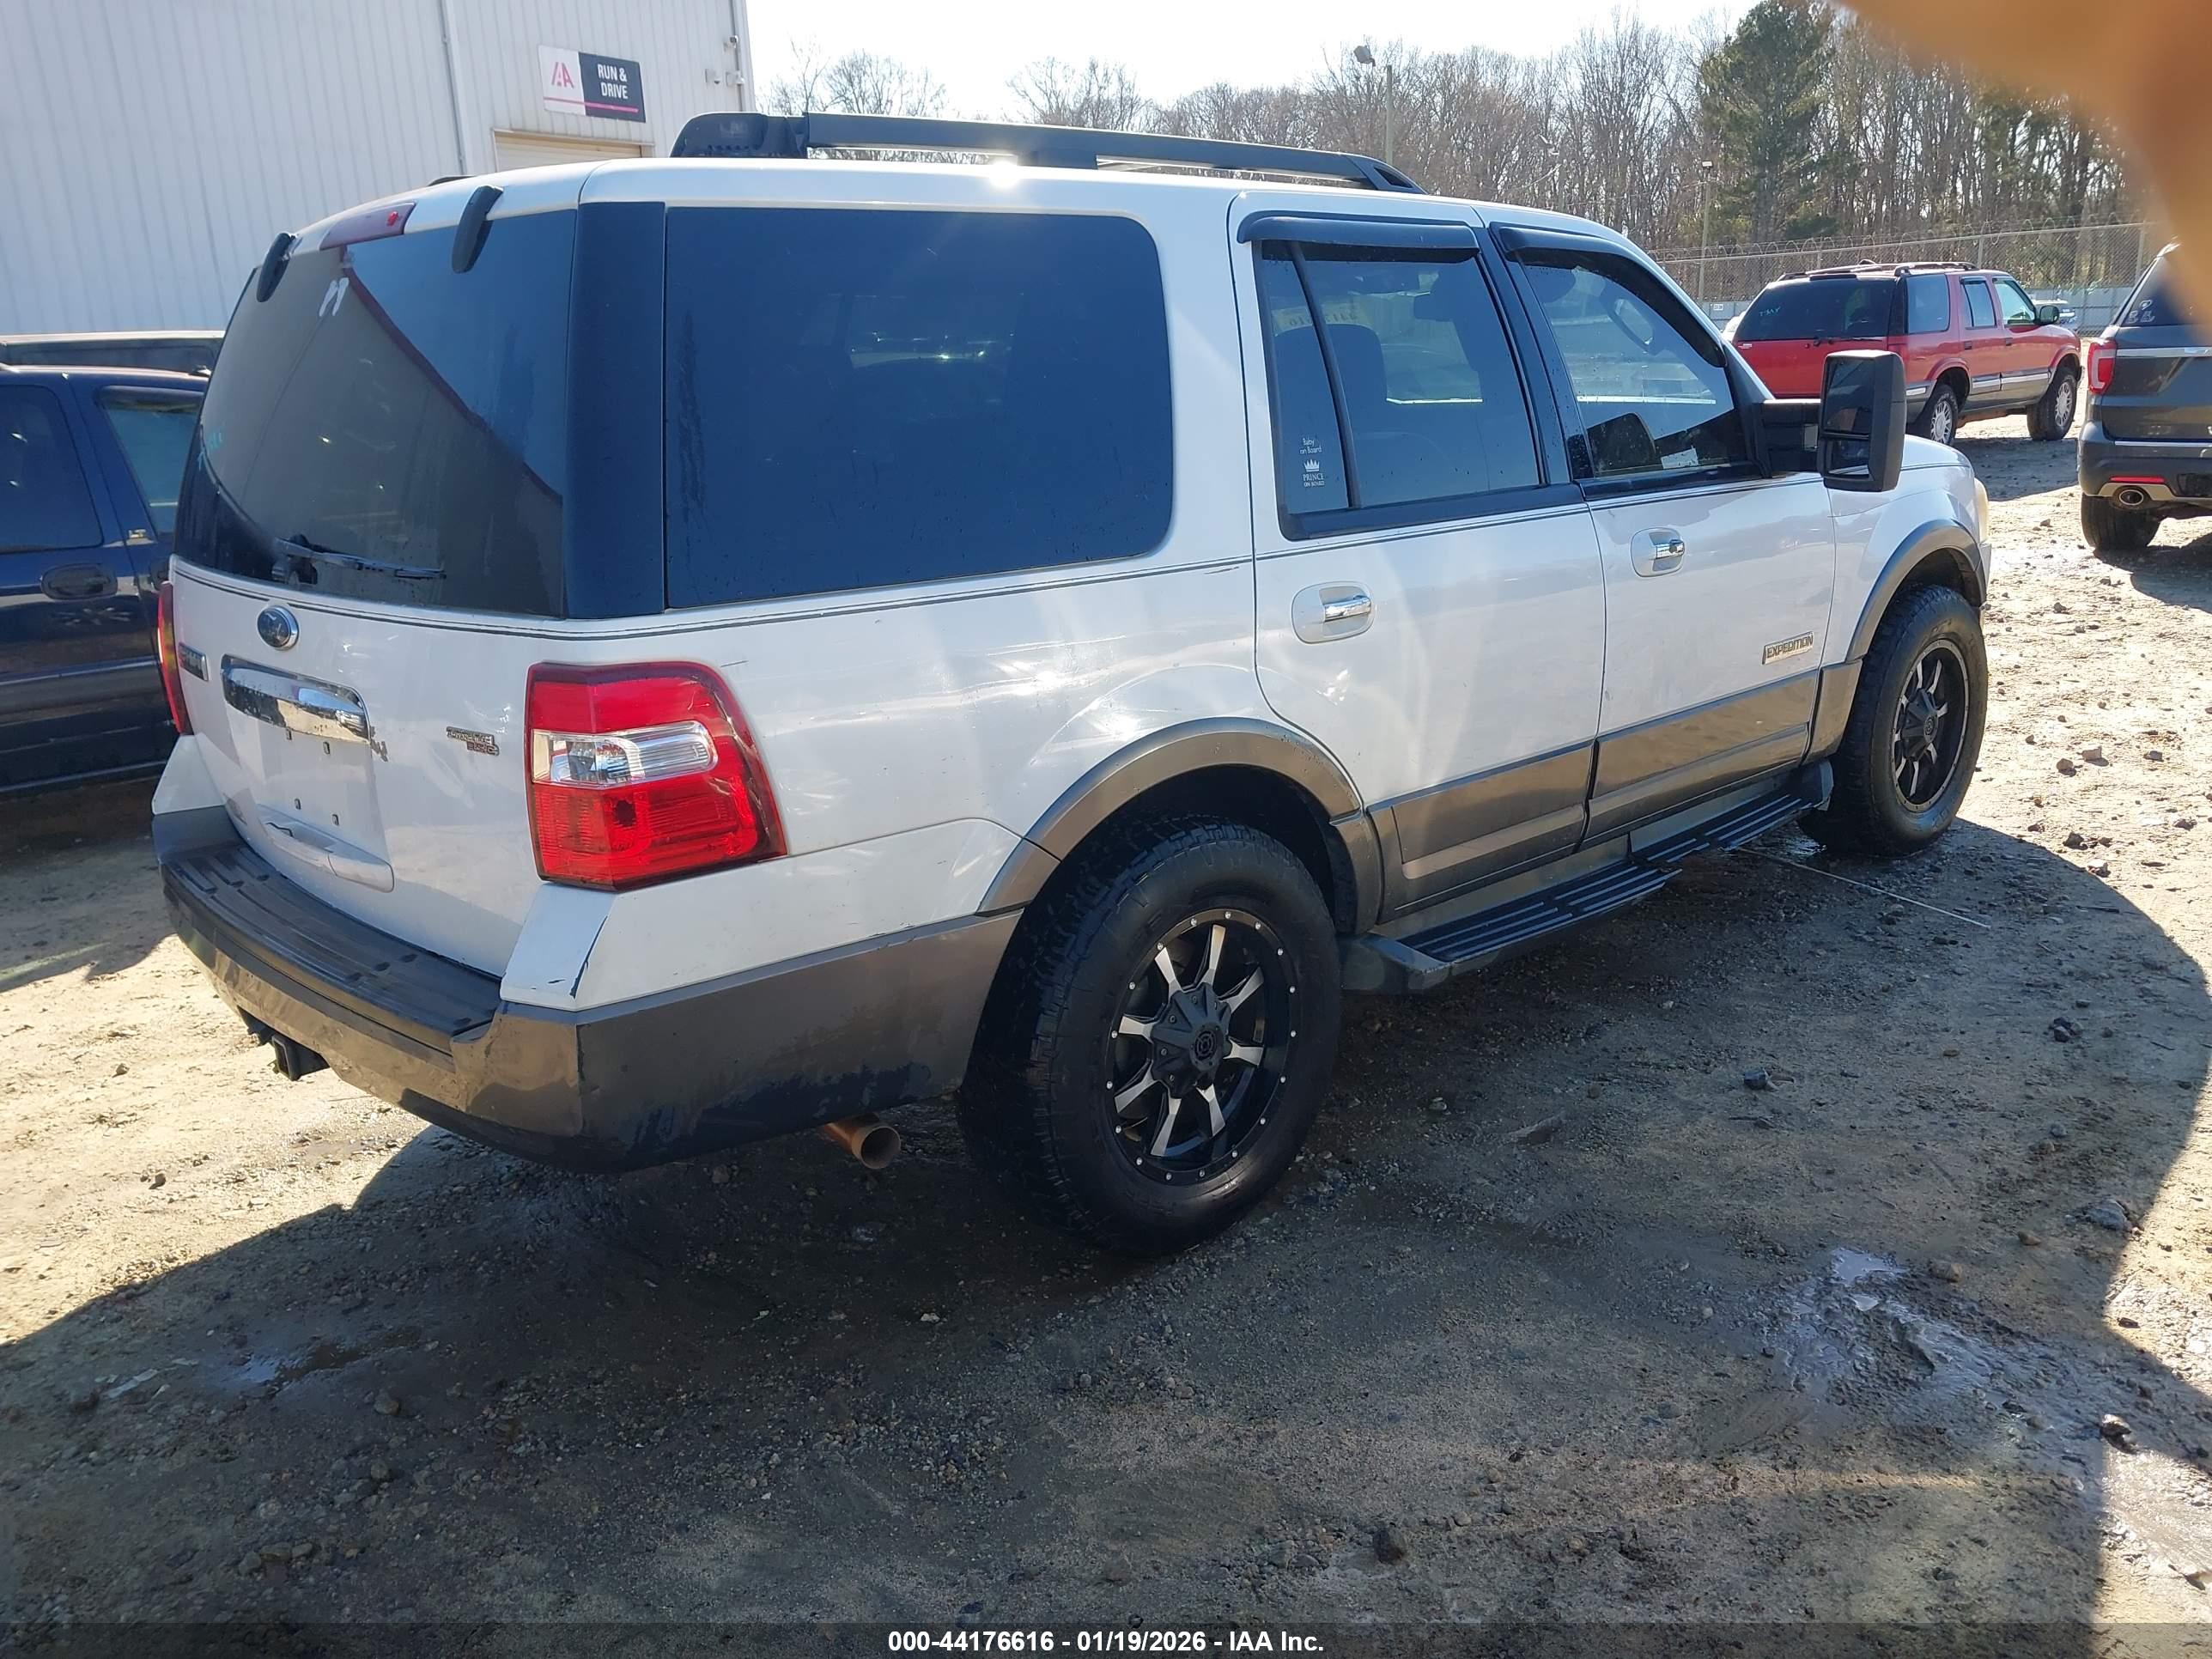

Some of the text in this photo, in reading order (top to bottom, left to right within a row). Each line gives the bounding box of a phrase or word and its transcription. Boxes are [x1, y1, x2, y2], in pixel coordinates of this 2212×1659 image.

[597, 64, 628, 82] RUN &
[600, 82, 629, 100] DRIVE
[1766, 635, 1814, 659] EXPEDITION
